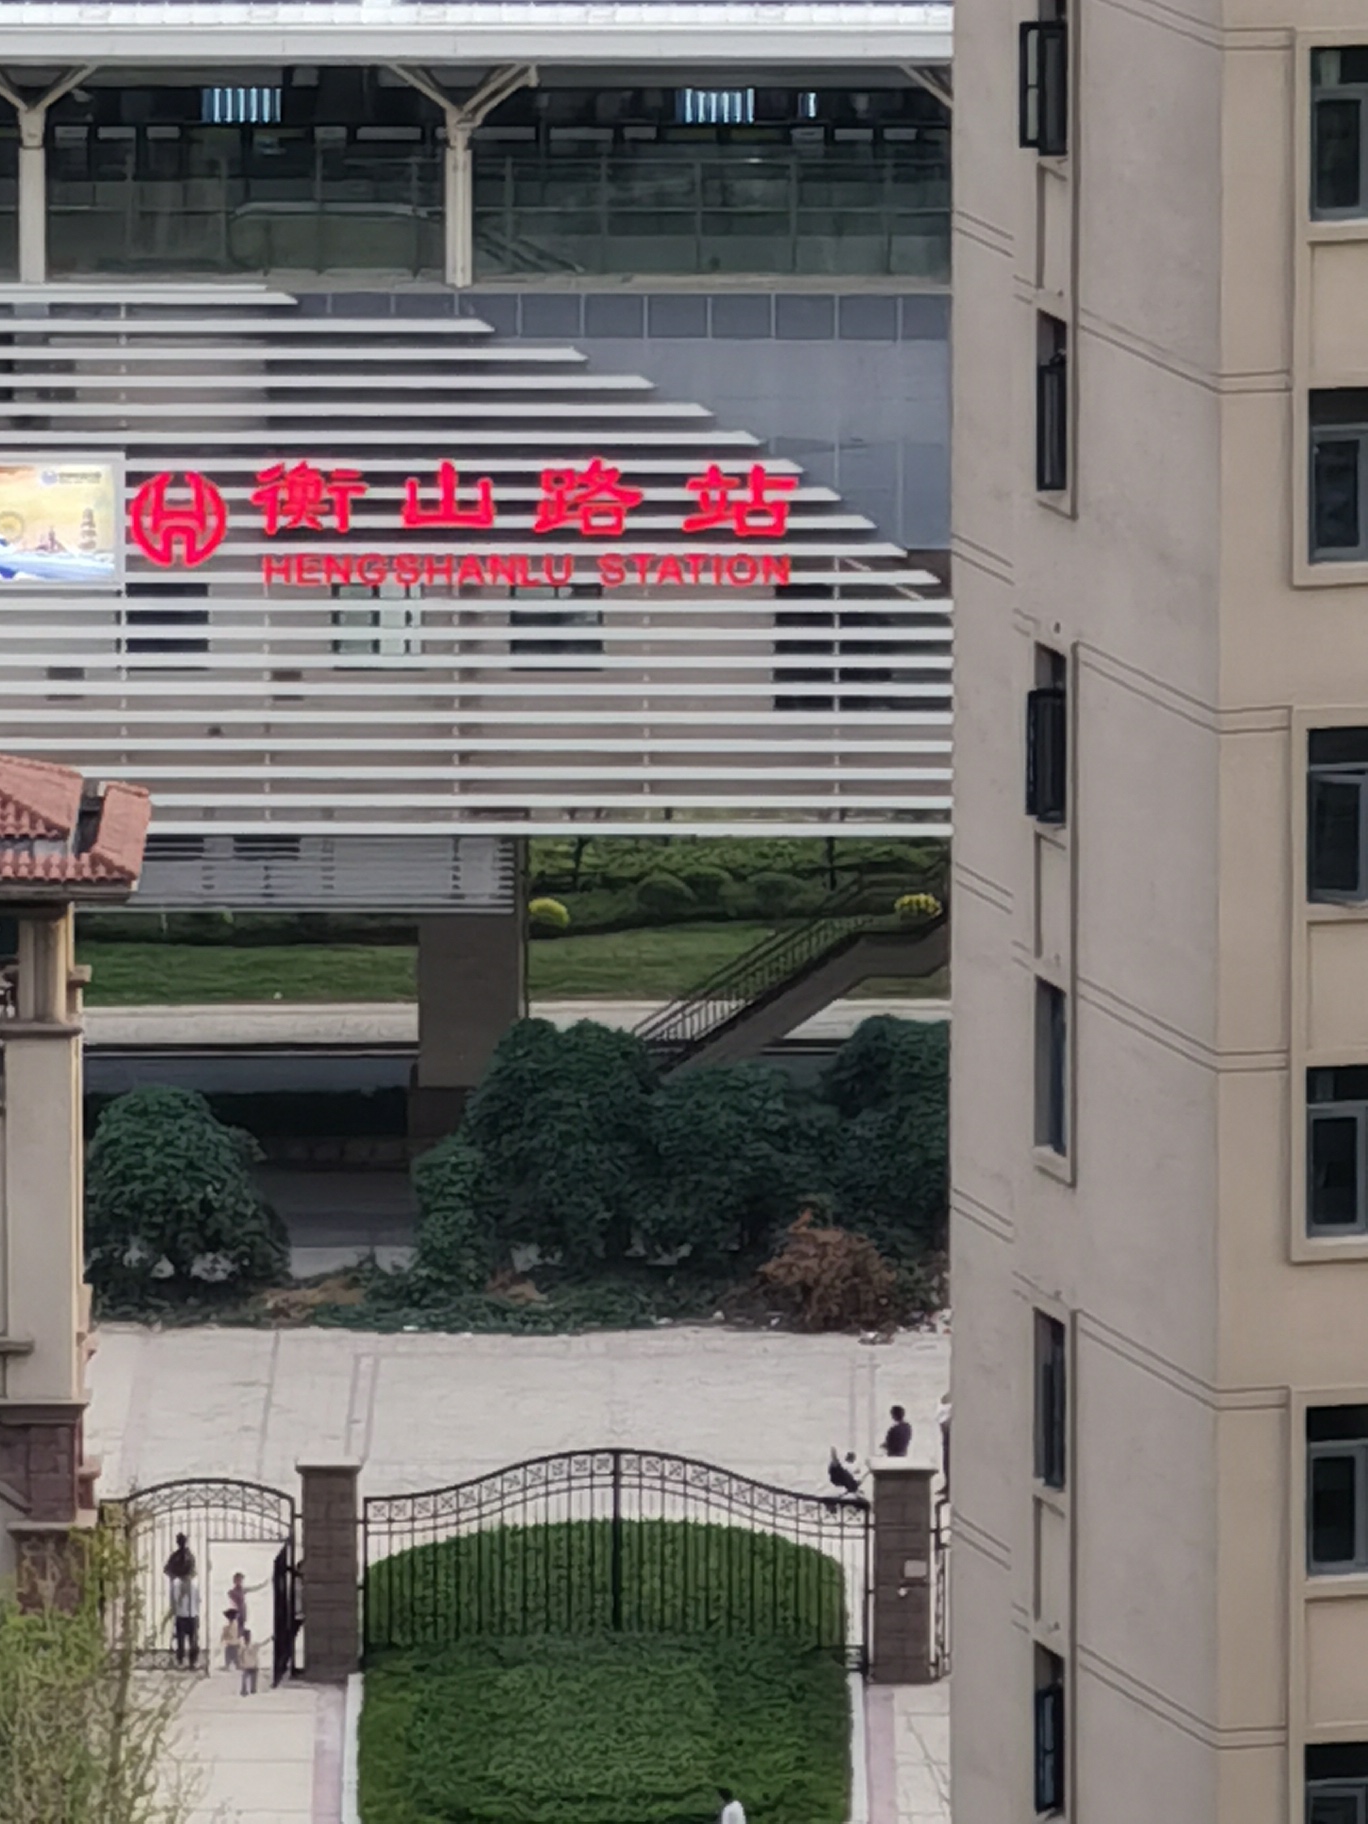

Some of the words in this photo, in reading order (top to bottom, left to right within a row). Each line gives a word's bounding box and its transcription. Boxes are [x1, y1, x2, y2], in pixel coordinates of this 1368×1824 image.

[249, 456, 799, 537] 衡山路站
[261, 552, 575, 588] HENGSHANLU
[595, 552, 791, 588] STATION
